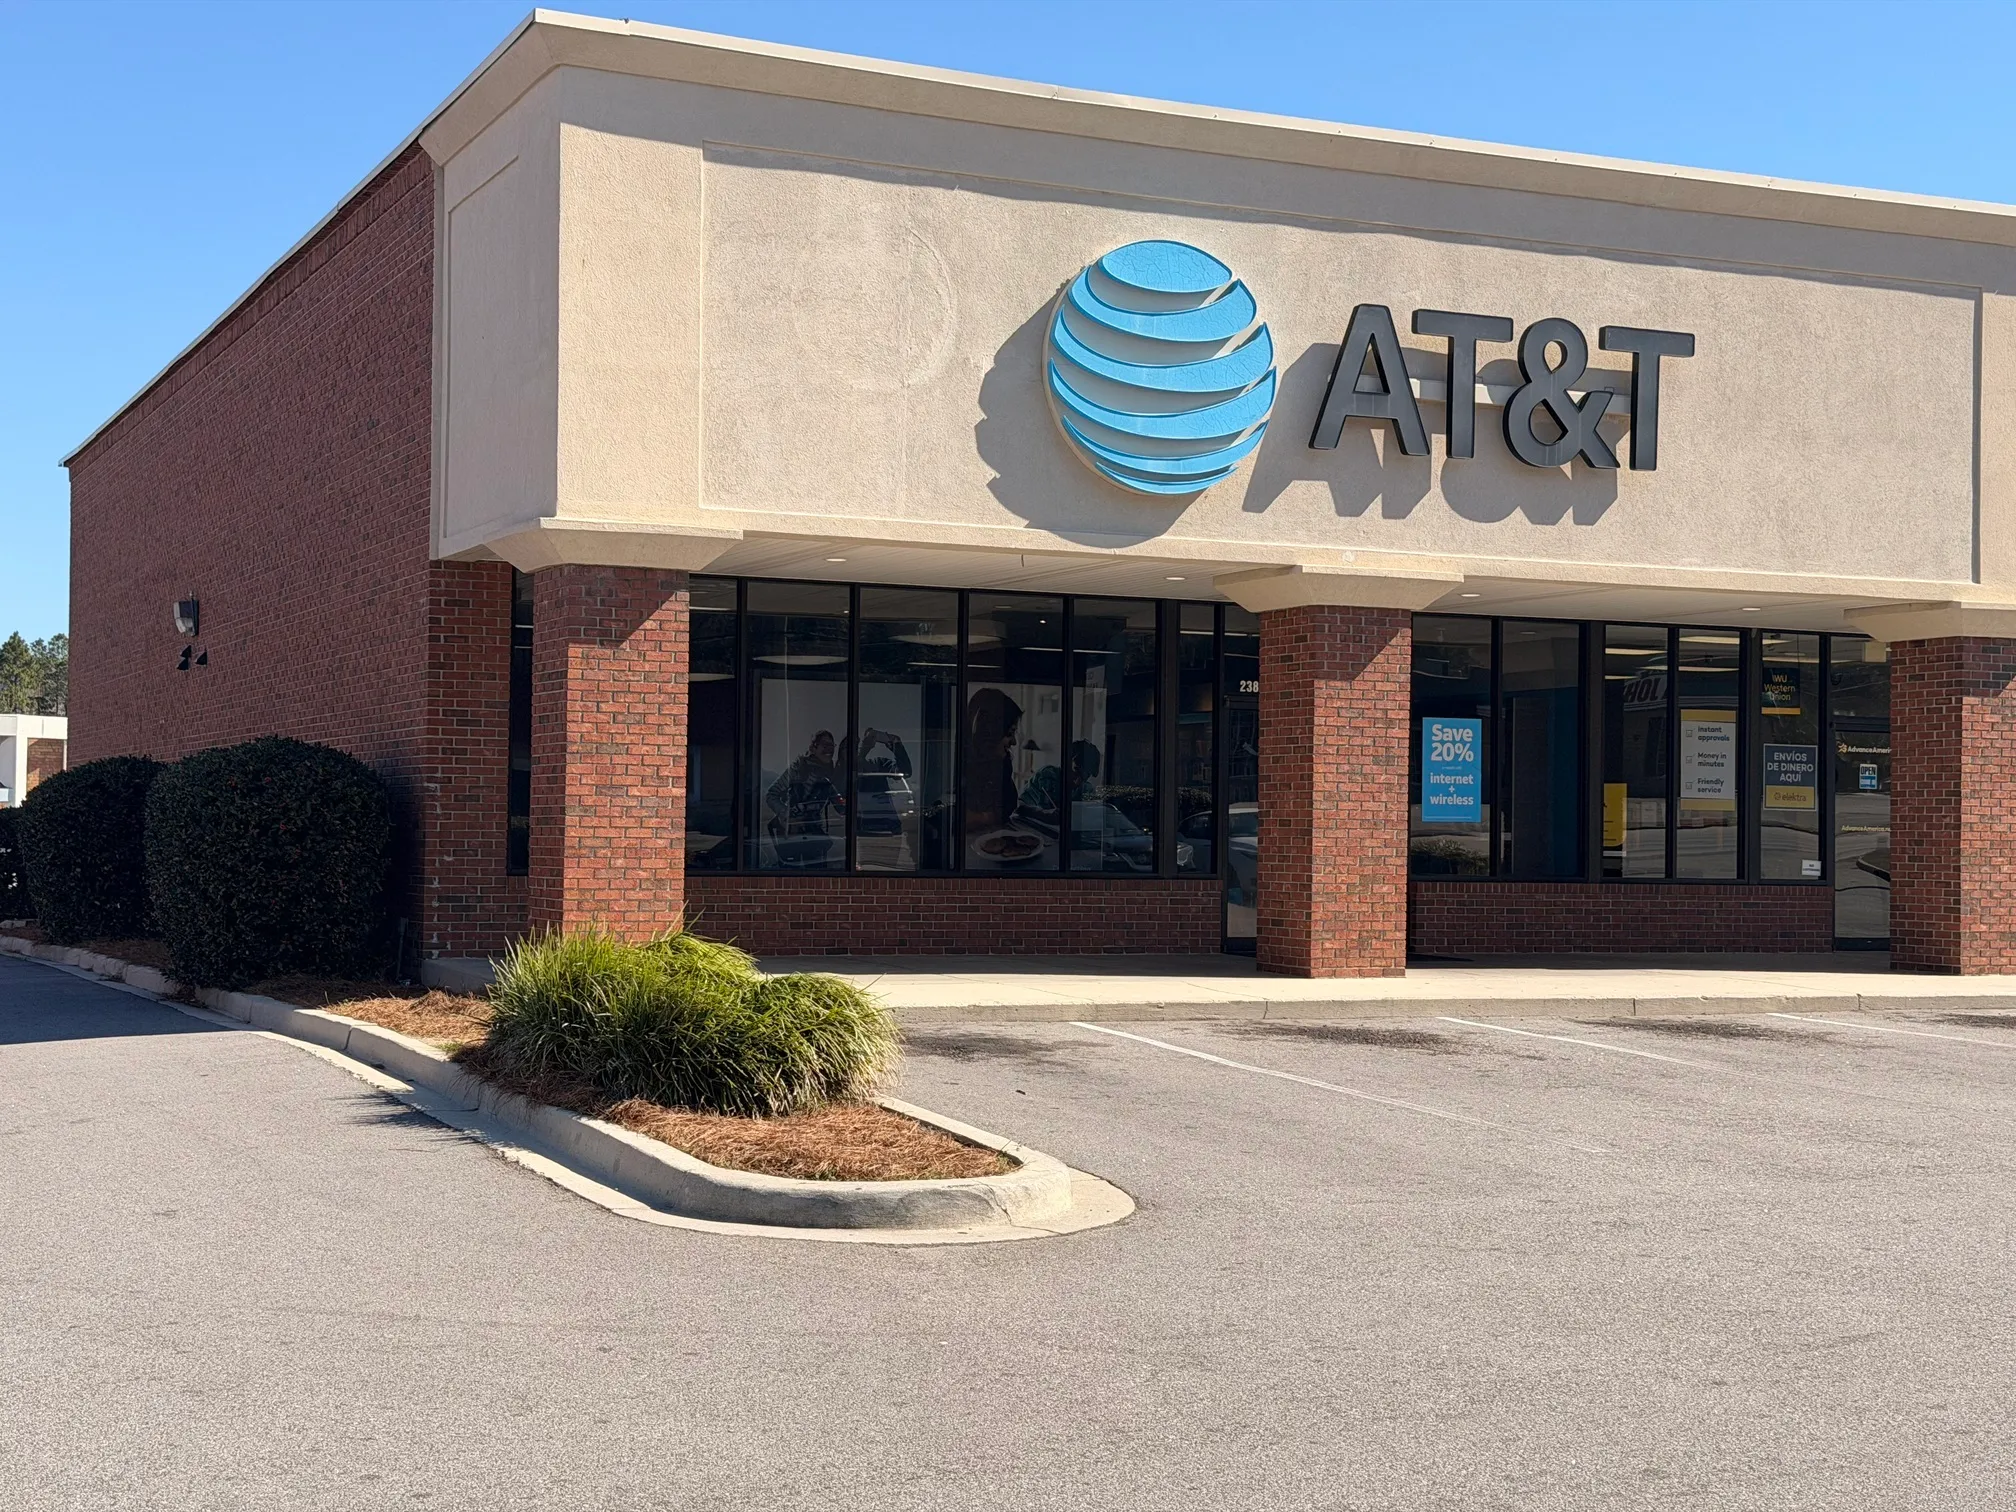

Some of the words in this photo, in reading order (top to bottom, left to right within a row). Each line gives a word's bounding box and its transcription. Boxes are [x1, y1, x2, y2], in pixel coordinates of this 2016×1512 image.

[1308, 303, 1696, 472] AT&T
[1240, 680, 1259, 693] 238
[1764, 683, 1796, 693] Western
[1432, 724, 1473, 741] Save
[1431, 743, 1474, 762] 20%
[1697, 752, 1719, 760] Money
[1774, 751, 1808, 761] ENVÍOS
[1766, 762, 1780, 771] DE
[1780, 763, 1814, 772] DINERO
[1860, 766, 1876, 776] OPEN
[1430, 772, 1474, 784] internet
[1780, 771, 1802, 782] AQUÍ
[1697, 778, 1724, 786] Friendly
[1449, 785, 1455, 793] +
[1430, 794, 1474, 805] wireless
[1781, 792, 1807, 802] elektra
